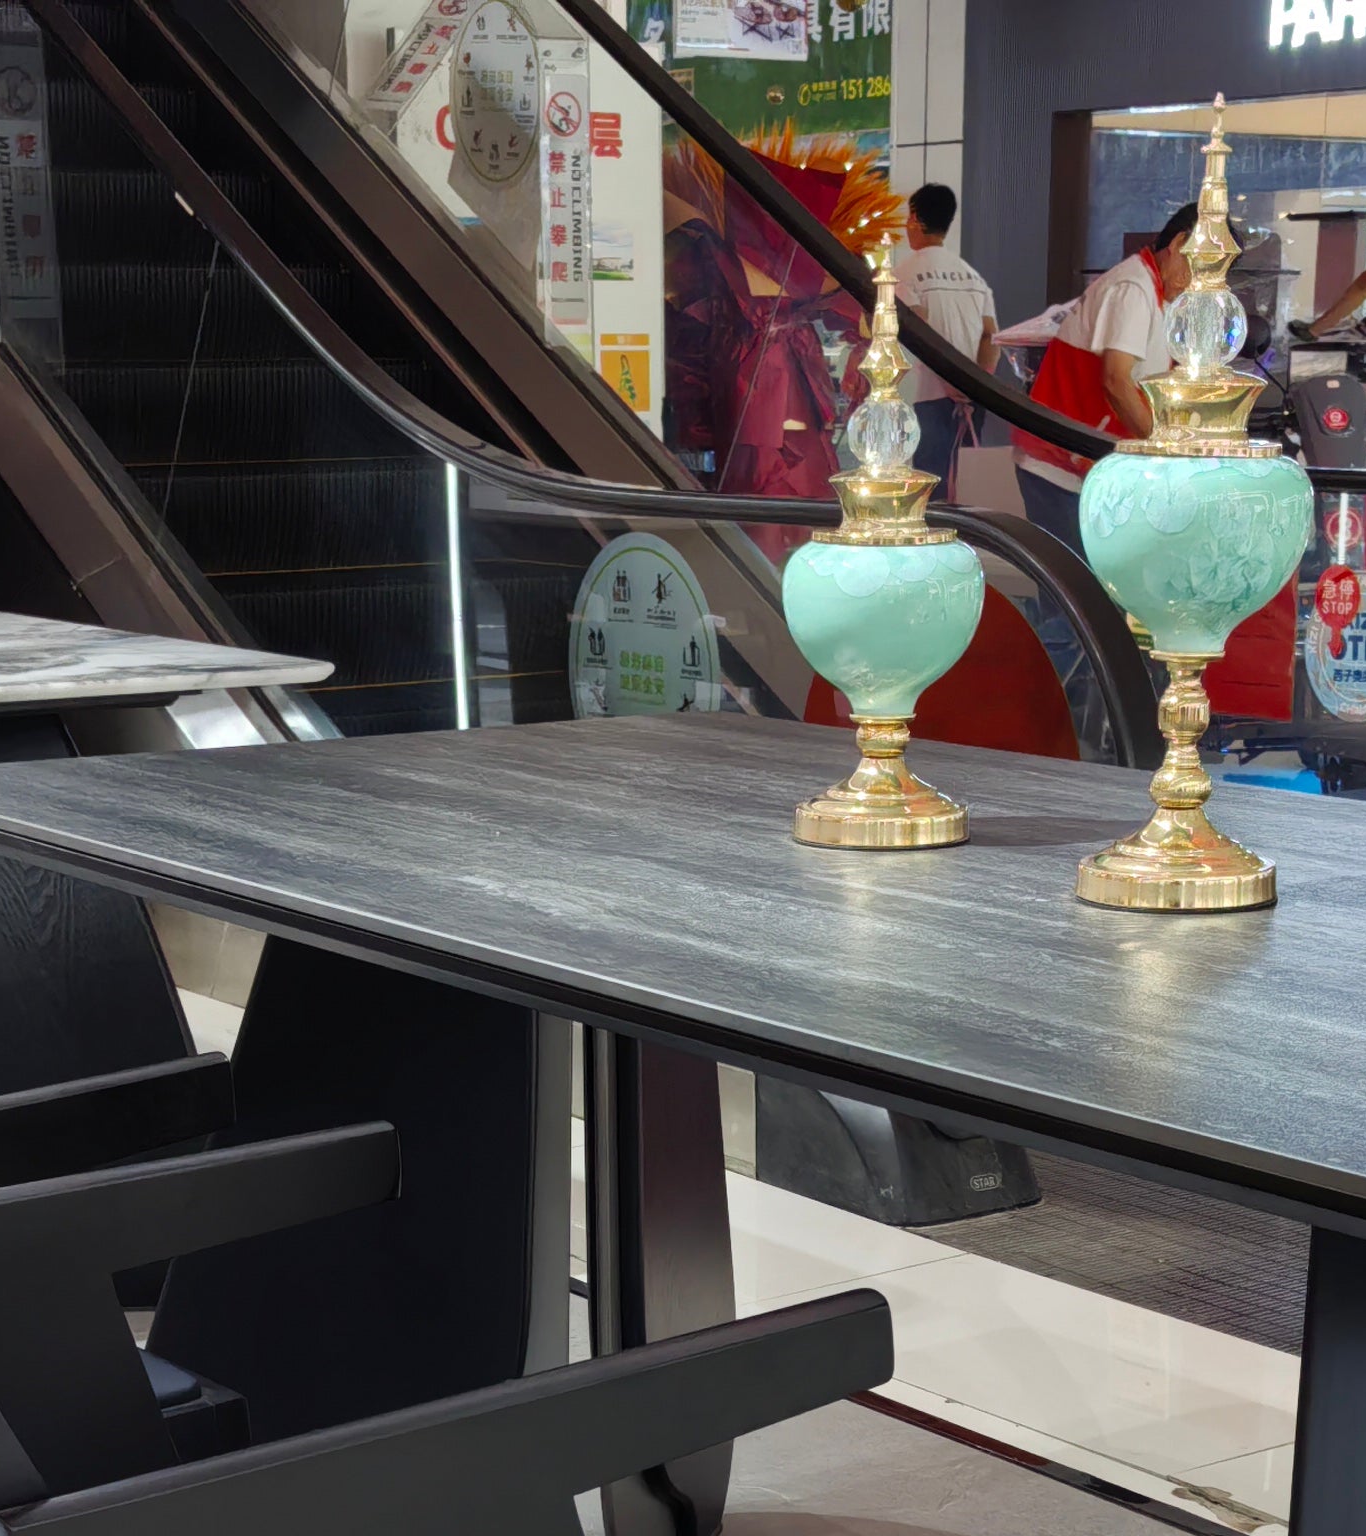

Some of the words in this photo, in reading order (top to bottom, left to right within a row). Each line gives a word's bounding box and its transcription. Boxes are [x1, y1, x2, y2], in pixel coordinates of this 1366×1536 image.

[840, 79, 863, 100] 151
[571, 154, 580, 181] NO
[571, 186, 584, 282] CLIMBING
[1322, 579, 1355, 601] 急停
[1322, 601, 1354, 615] STOP
